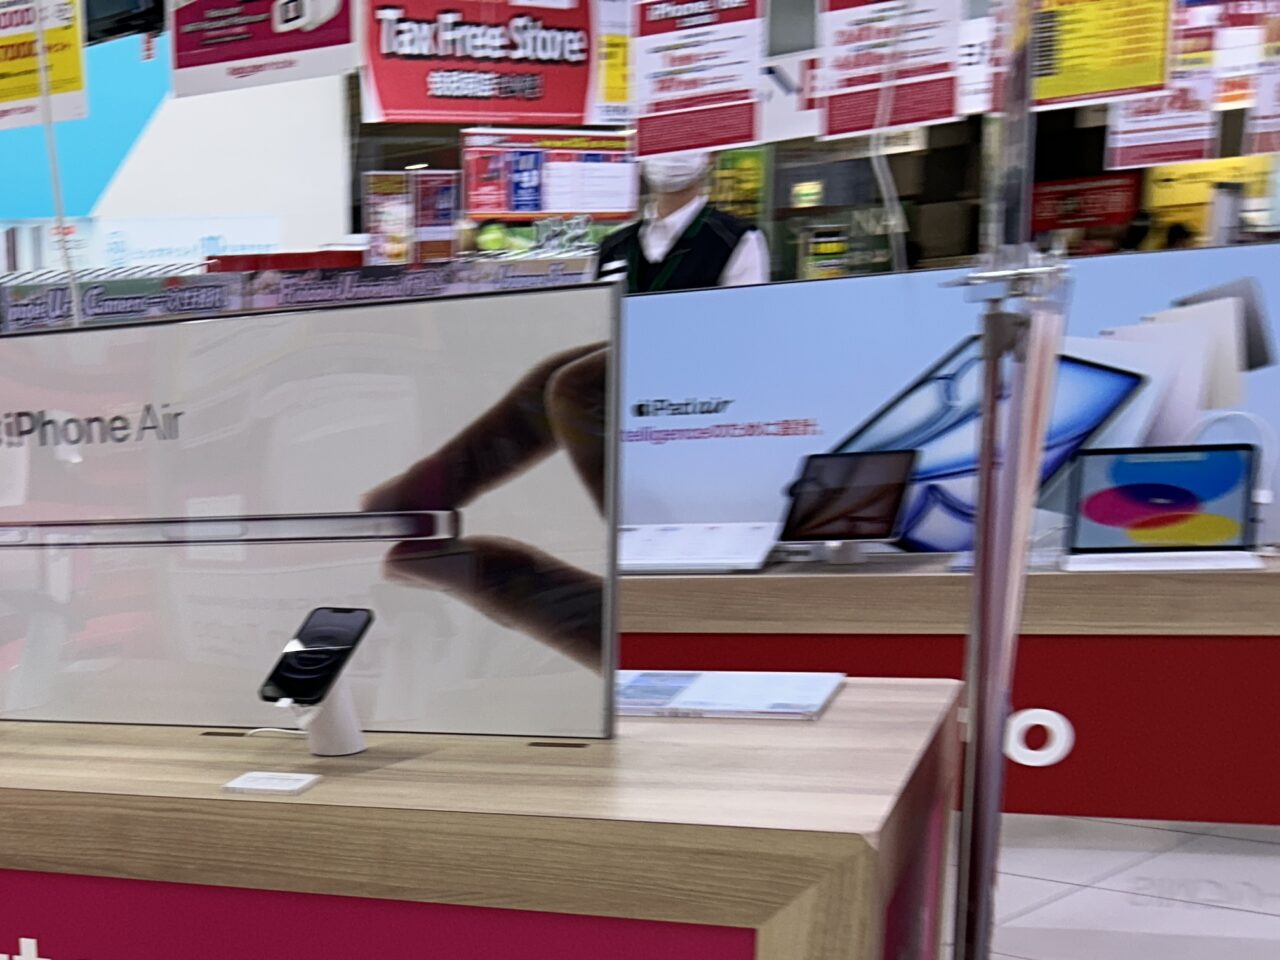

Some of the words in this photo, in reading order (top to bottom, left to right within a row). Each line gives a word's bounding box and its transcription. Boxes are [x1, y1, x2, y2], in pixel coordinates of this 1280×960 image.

[375, 8, 436, 55] Tax
[436, 12, 510, 59] Free
[508, 15, 588, 62] Store
[3, 410, 131, 448] iPhone
[134, 403, 184, 442] Air
